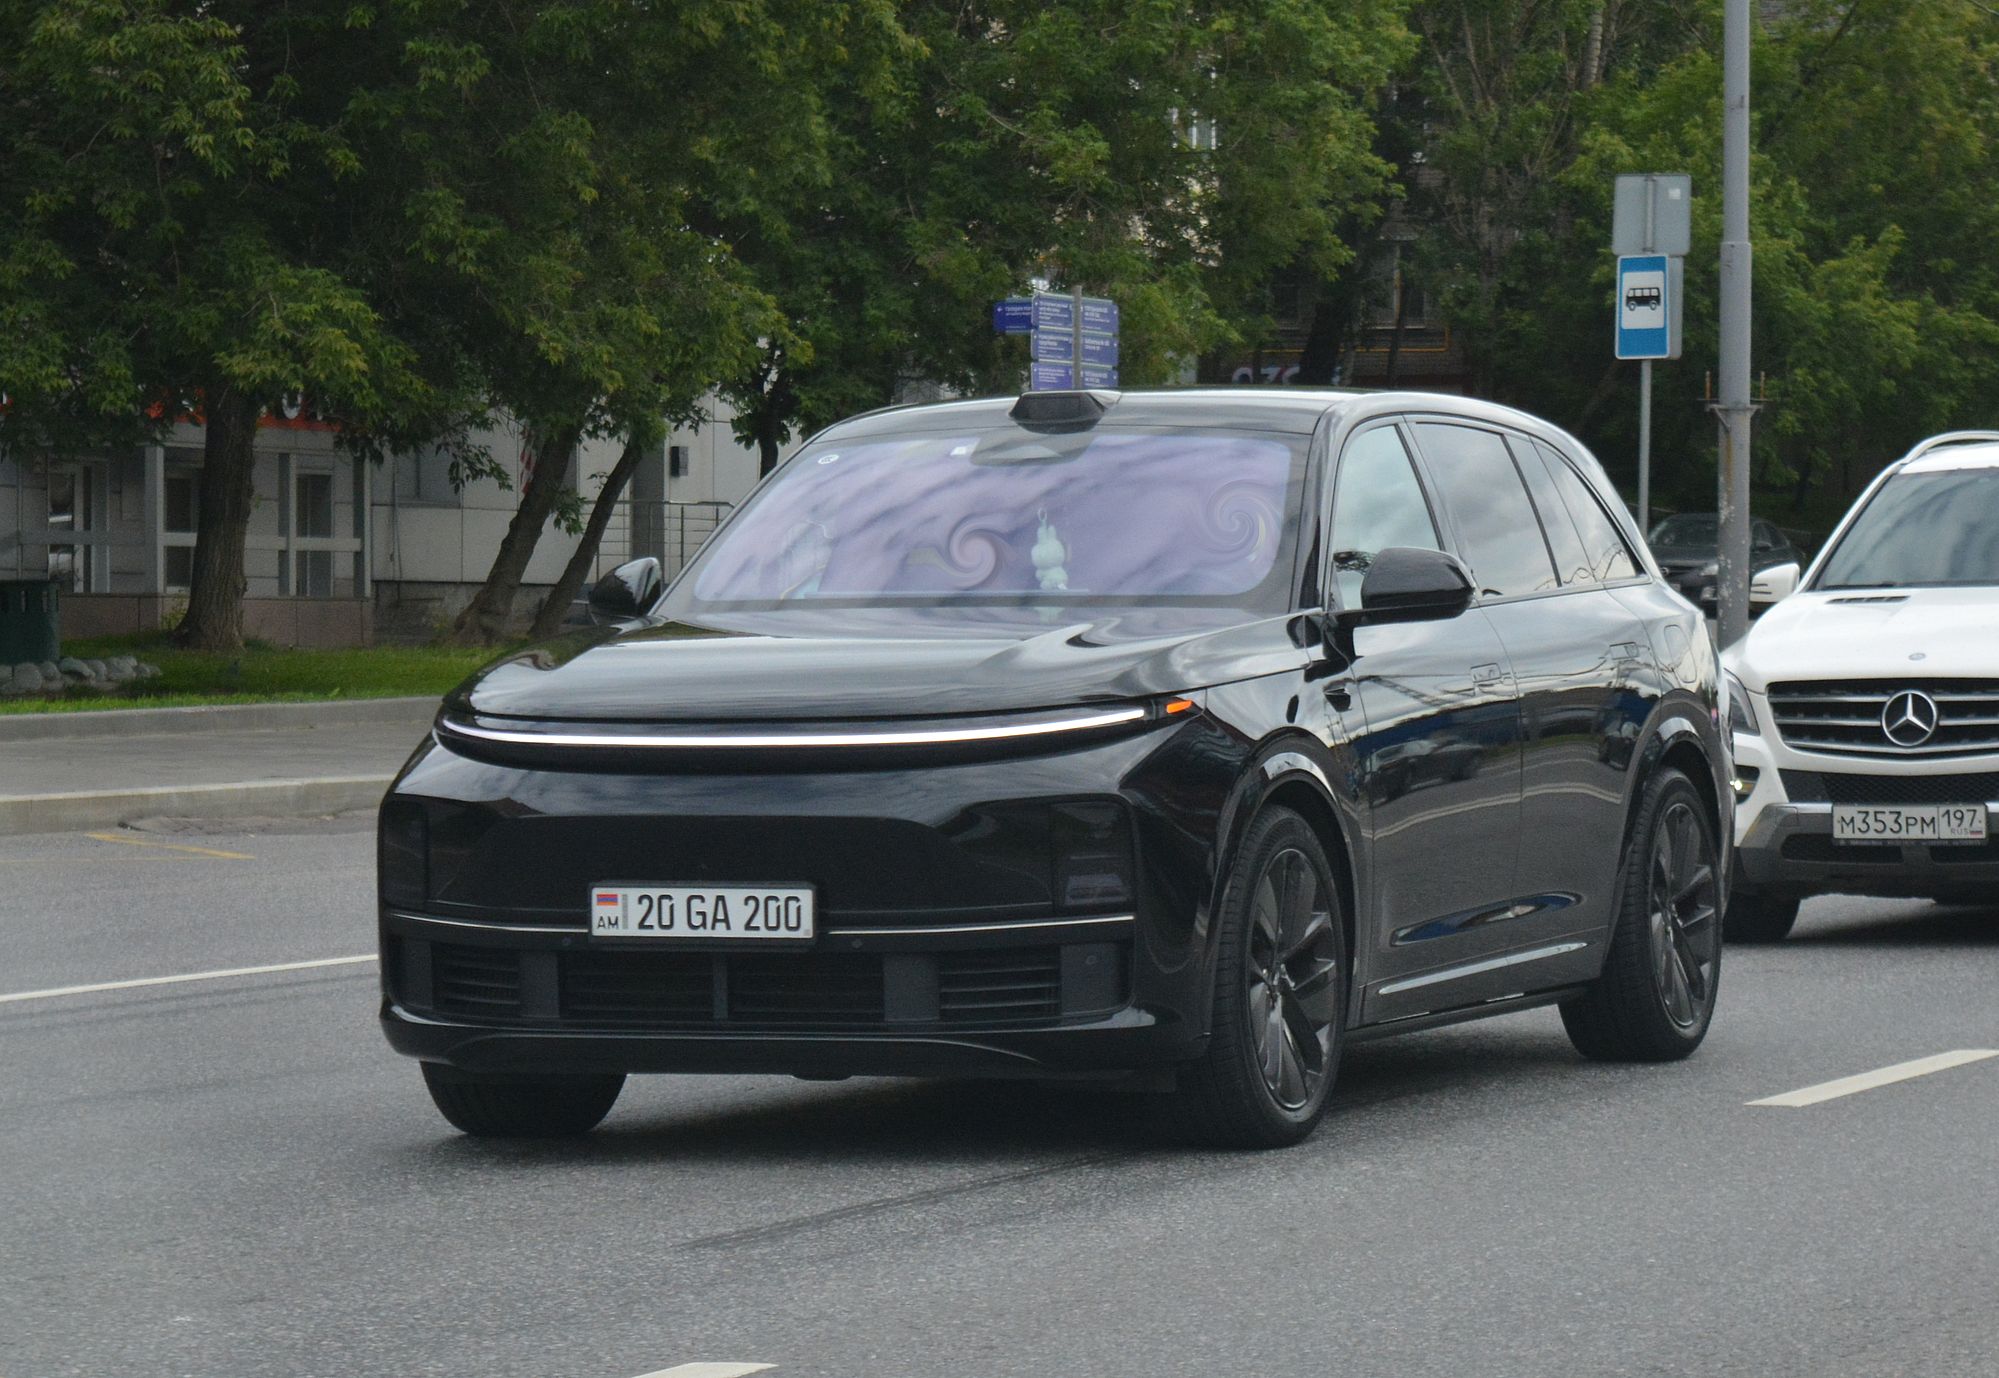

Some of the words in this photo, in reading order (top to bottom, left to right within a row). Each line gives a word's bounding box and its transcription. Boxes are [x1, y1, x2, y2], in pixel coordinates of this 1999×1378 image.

[1840, 810, 1936, 834] М353РМ
[1941, 809, 1977, 828] 197
[596, 916, 619, 930] AM
[637, 894, 675, 931] 20
[686, 894, 732, 931] GA
[744, 895, 802, 932] 200
